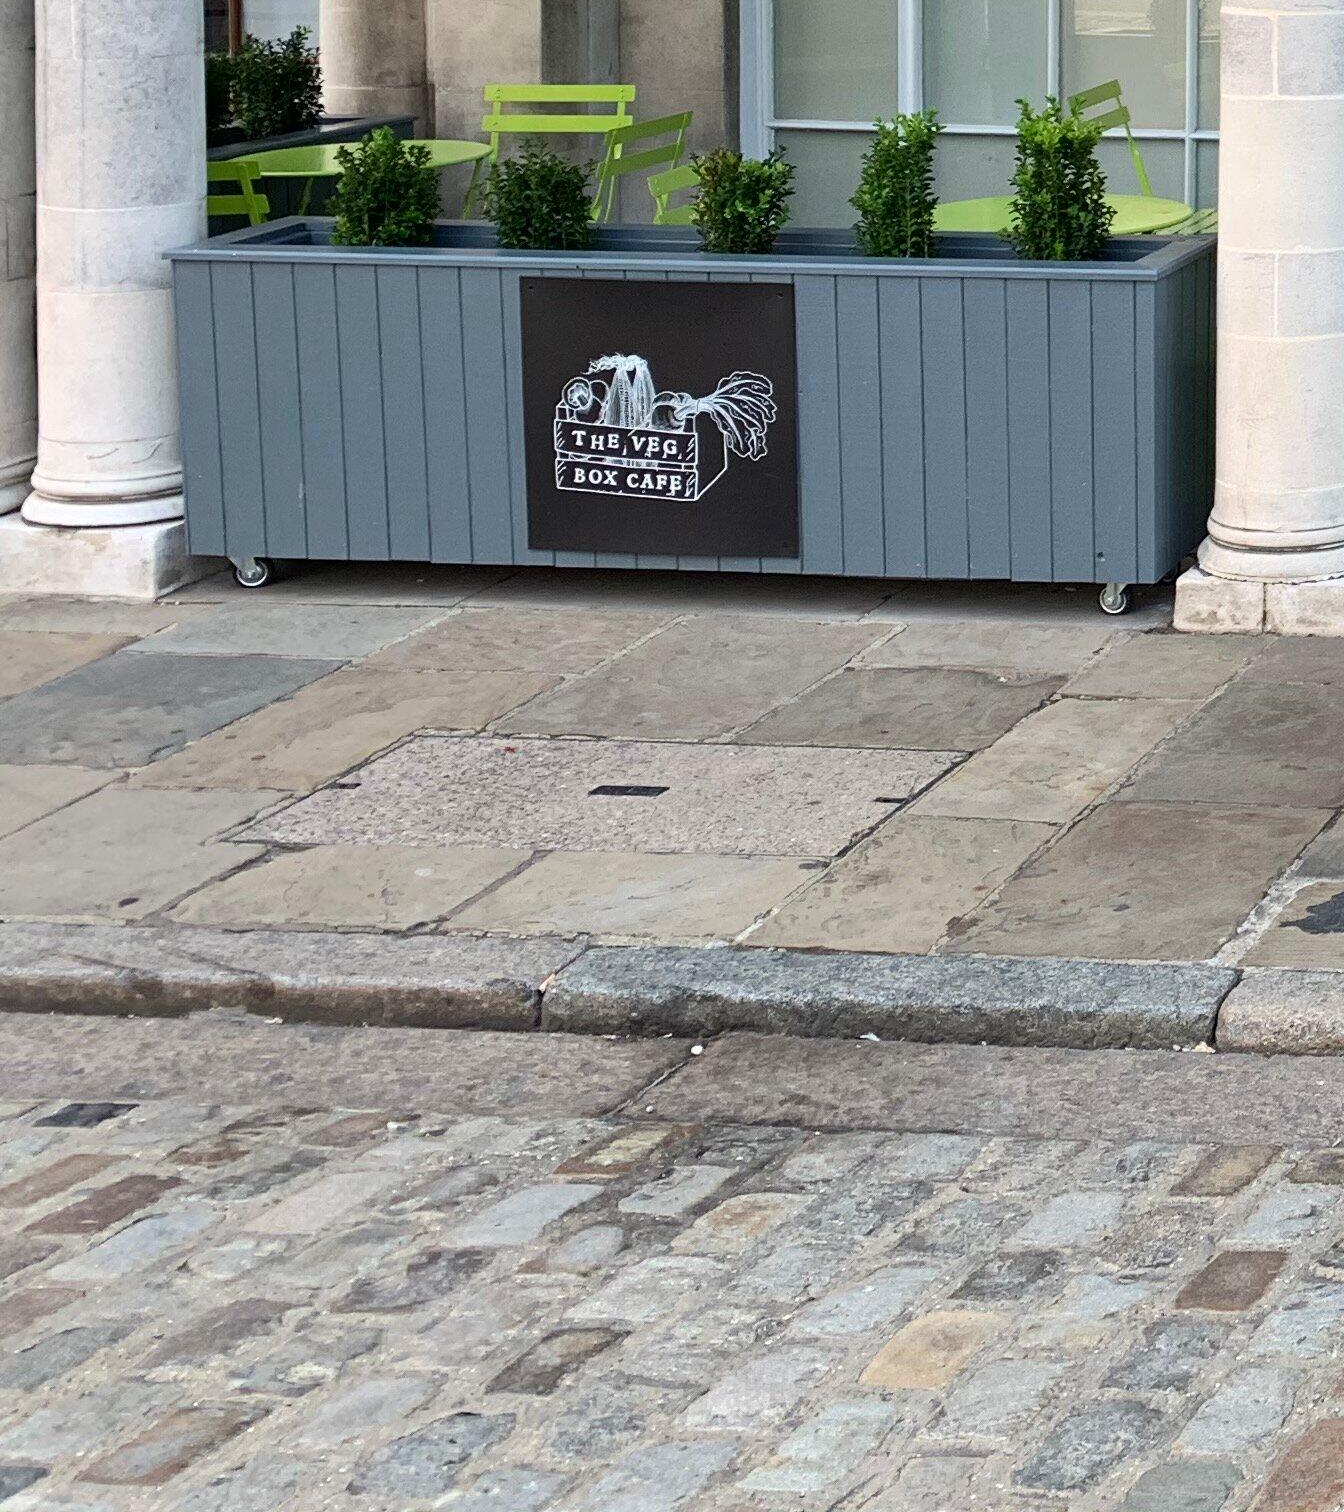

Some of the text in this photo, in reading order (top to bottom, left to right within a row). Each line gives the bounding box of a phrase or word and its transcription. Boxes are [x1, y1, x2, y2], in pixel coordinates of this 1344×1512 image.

[571, 430, 678, 456] THE VEG
[573, 468, 683, 494] BOX CAFE
